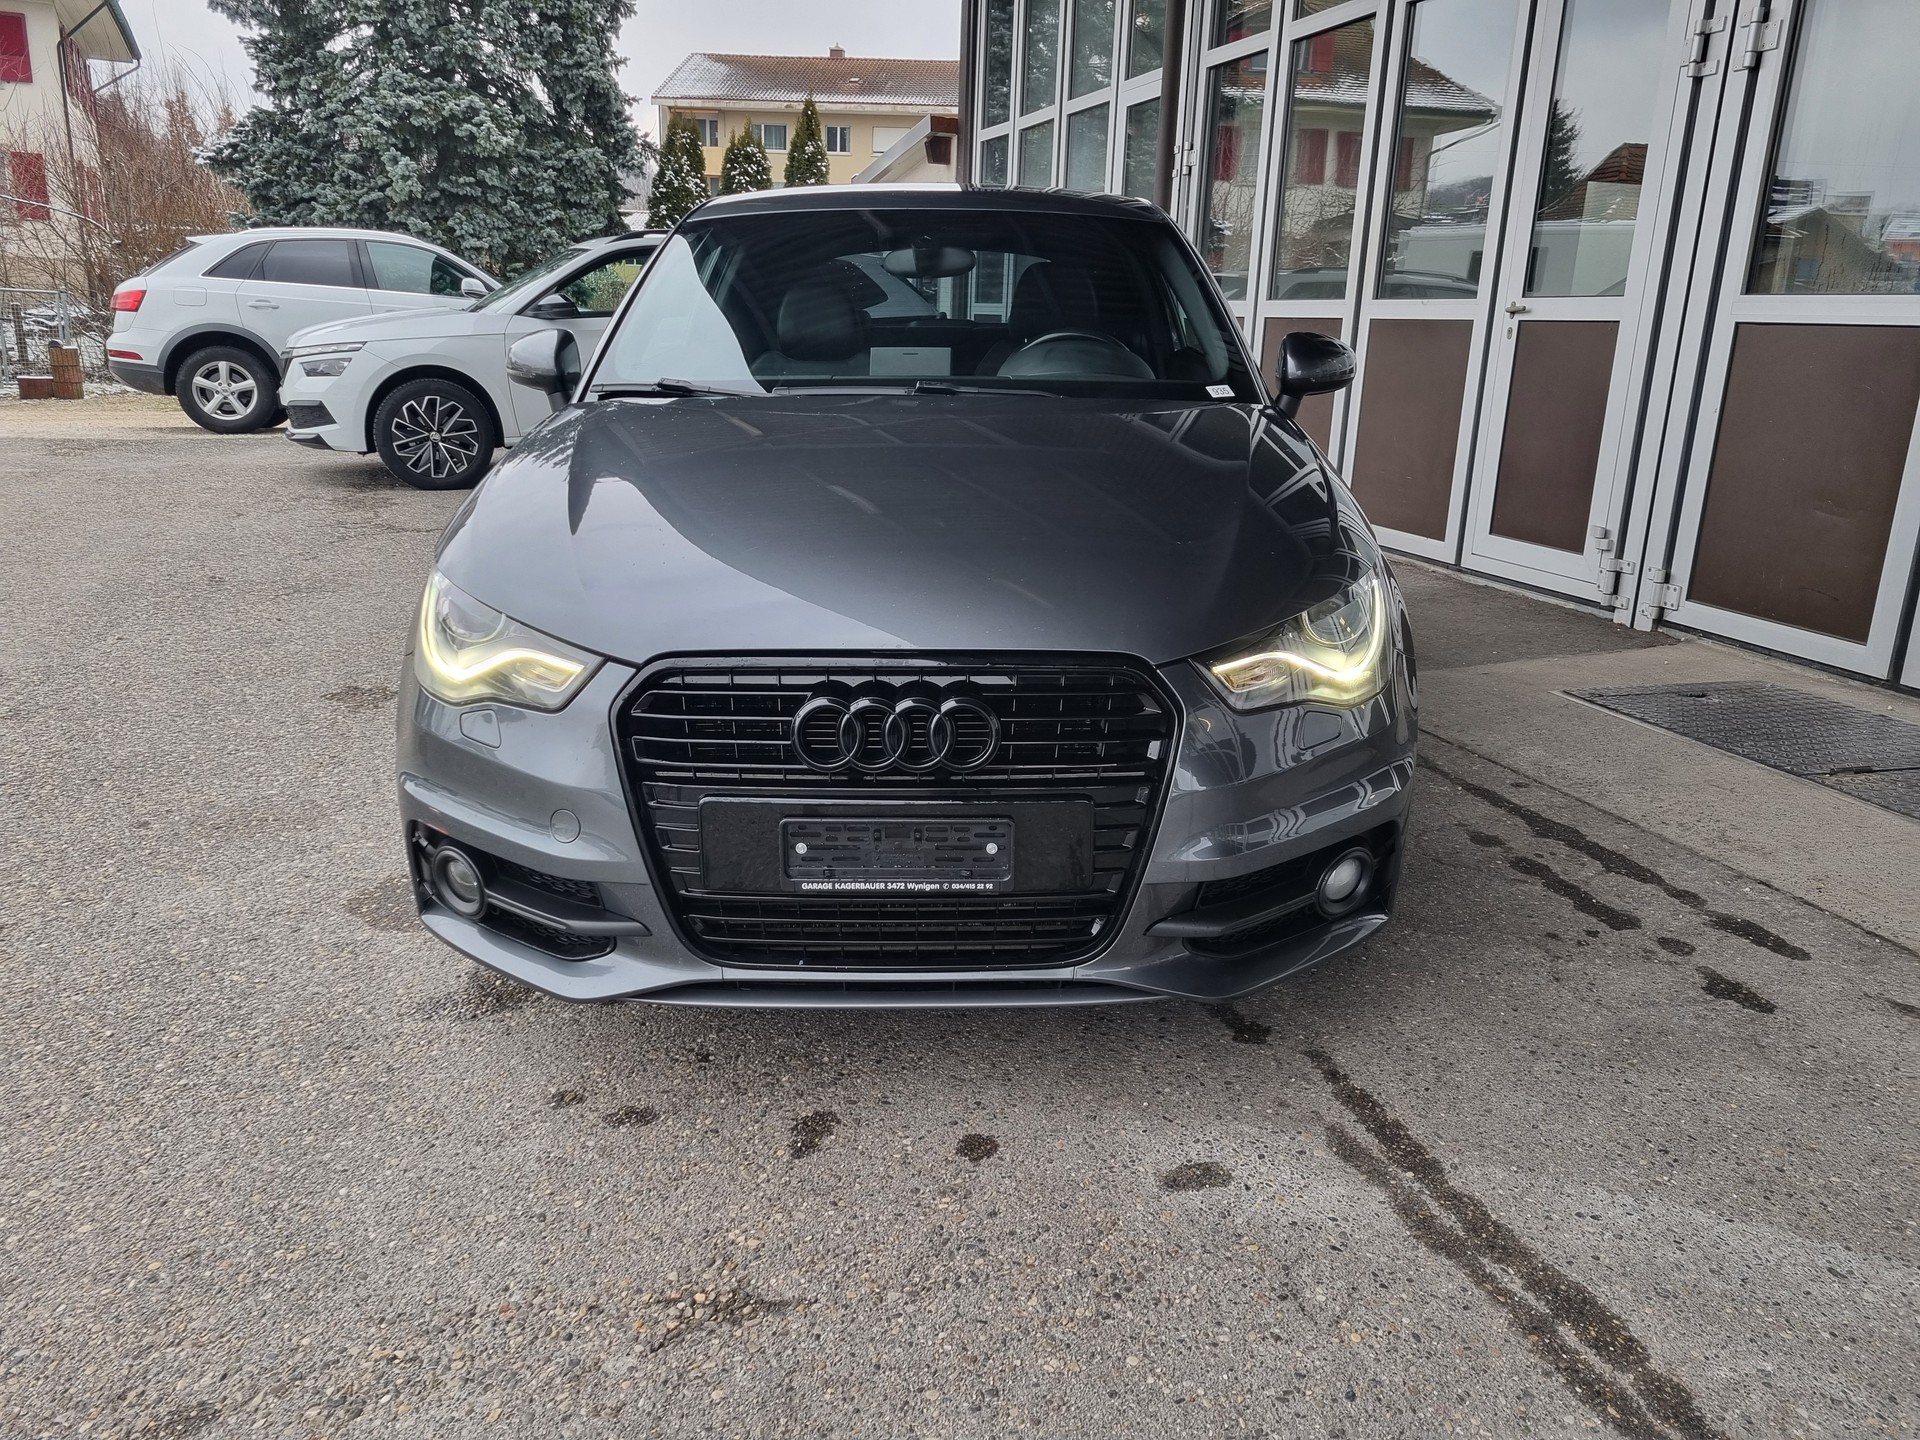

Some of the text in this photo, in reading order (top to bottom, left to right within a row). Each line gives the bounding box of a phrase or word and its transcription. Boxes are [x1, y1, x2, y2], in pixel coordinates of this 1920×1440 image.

[802, 882, 833, 890] GARAGE
[834, 882, 885, 890] KAGERBAUER
[886, 882, 905, 890] 3472
[906, 882, 940, 891] Wynigen
